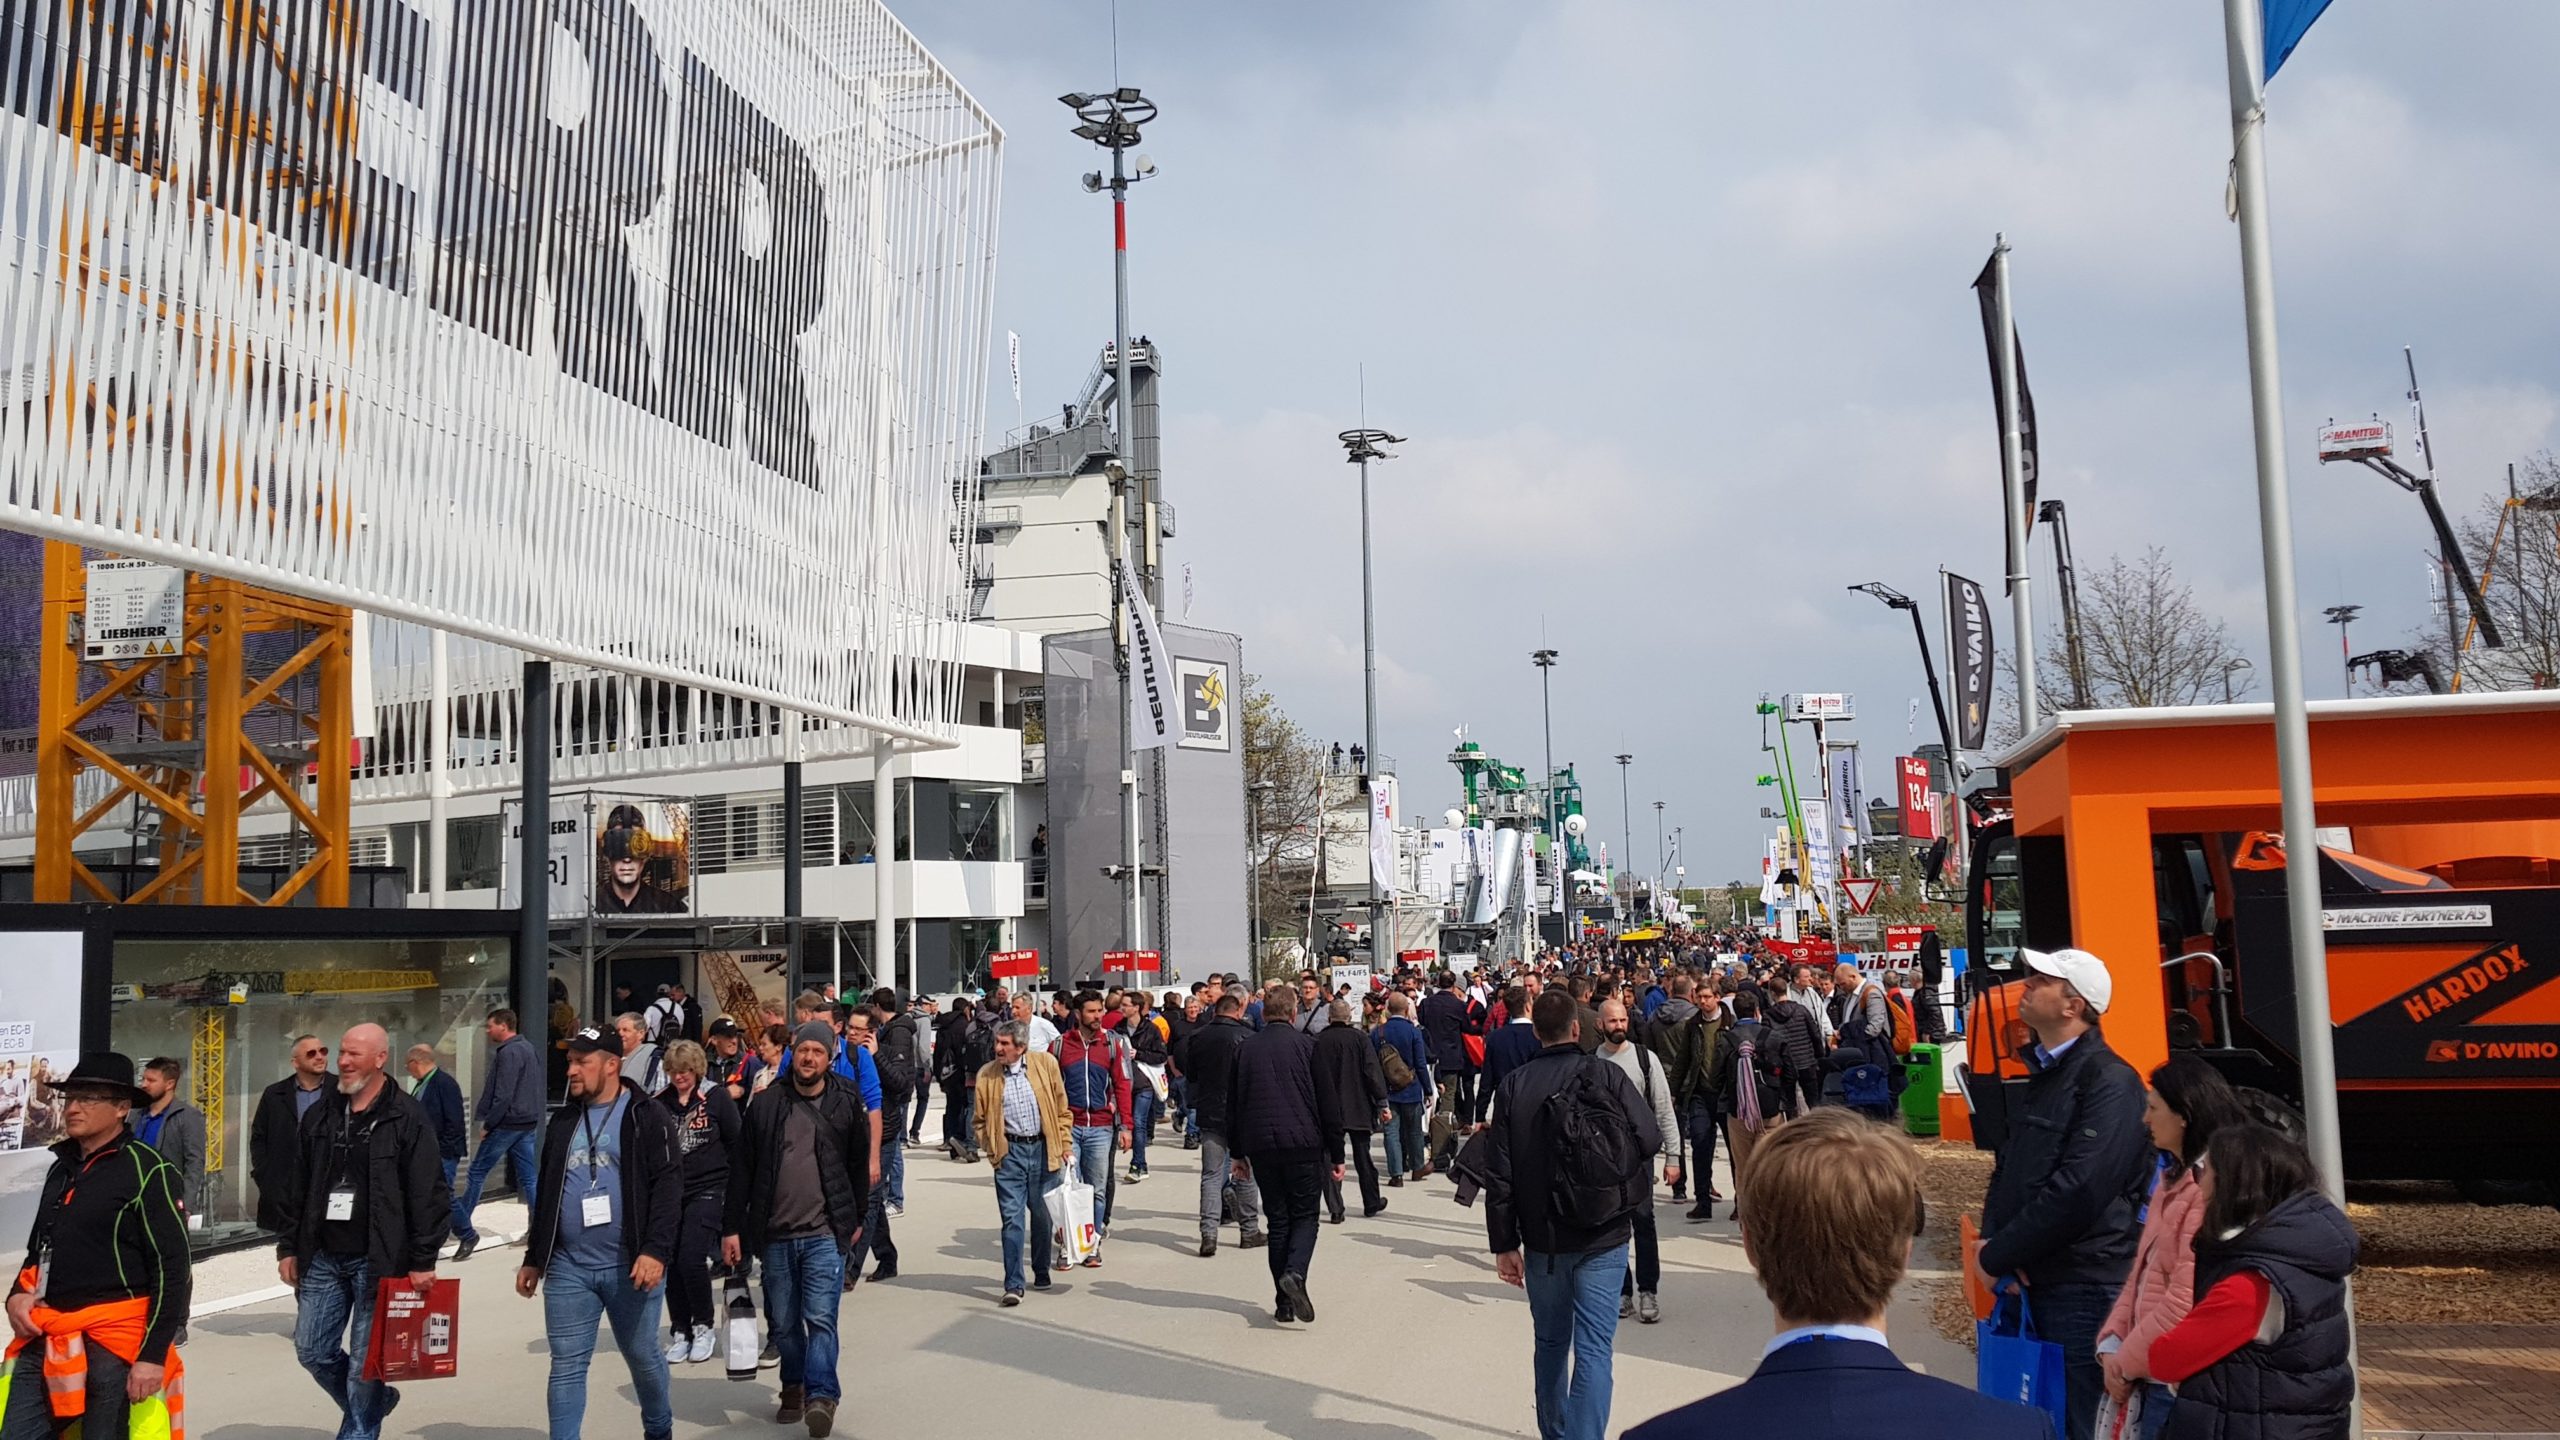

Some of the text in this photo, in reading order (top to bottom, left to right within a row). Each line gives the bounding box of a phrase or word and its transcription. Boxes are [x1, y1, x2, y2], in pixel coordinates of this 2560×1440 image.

[0, 0, 826, 495] ERR
[1107, 351, 1145, 361] AMNN
[2334, 427, 2384, 440] MANITOU
[101, 626, 167, 639] LIEBHERR
[1962, 582, 1983, 692] D'AVINO
[1904, 758, 1927, 777] Tor Gate
[1908, 782, 1930, 813] 13.4
[513, 820, 577, 839] LIERR
[2336, 911, 2400, 924] MACHINE
[2402, 910, 2463, 922] PARTNER
[1887, 927, 1907, 935] Block
[740, 953, 783, 963] LIEBHERR
[992, 952, 1010, 962] Block
[2403, 944, 2531, 1023] HARDOX
[10, 1024, 31, 1036] EC-B
[578, 1027, 600, 1041] CB
[2465, 1042, 2559, 1059] D'AVINO
